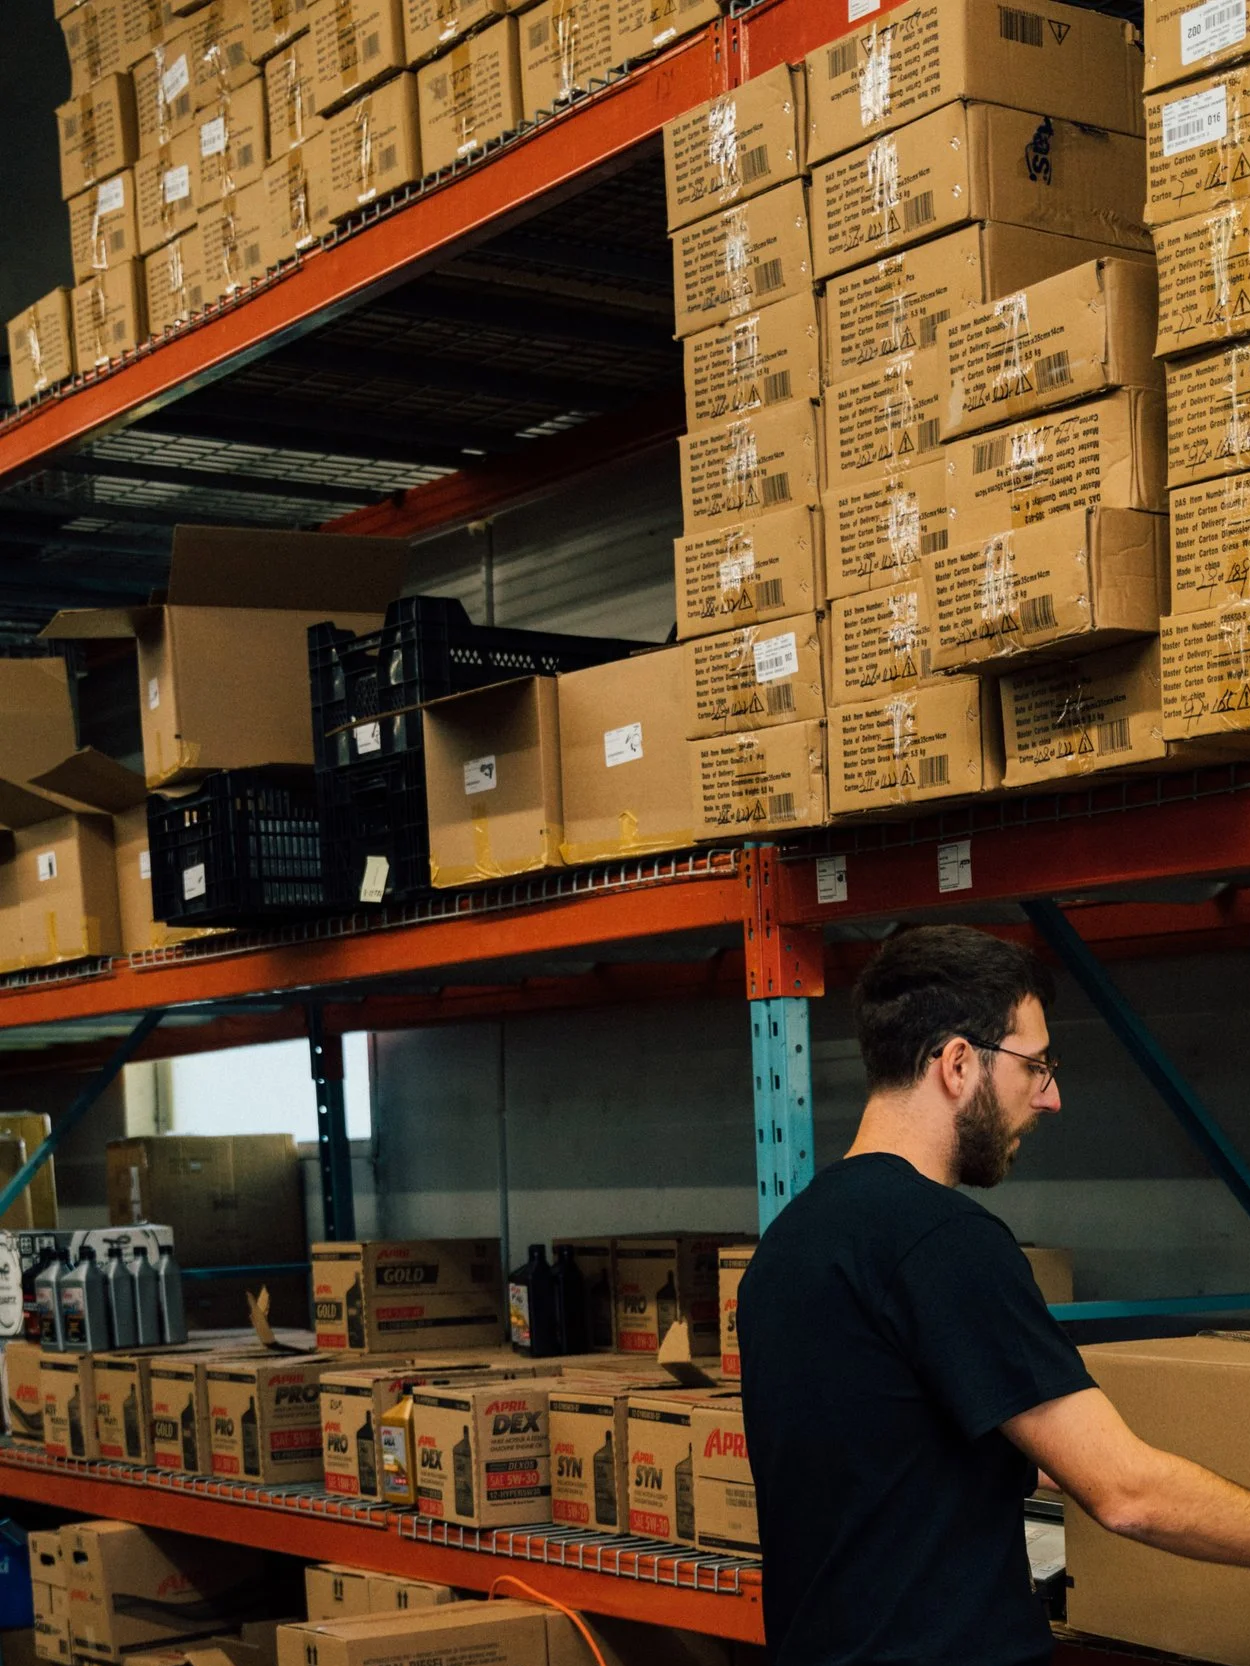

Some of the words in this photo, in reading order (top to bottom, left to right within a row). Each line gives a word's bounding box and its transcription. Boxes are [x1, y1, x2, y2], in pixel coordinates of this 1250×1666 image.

[1207, 112, 1221, 126] 016
[317, 1303, 337, 1318] GOLD
[485, 1400, 529, 1416] APRIL
[493, 1411, 542, 1435] DEX
[327, 1434, 348, 1454] PRO
[554, 1443, 575, 1455] APRIL
[704, 1428, 748, 1459] APR
[421, 1448, 442, 1470] DEX
[557, 1456, 583, 1479] SYN
[632, 1451, 655, 1465] APRIL
[635, 1466, 663, 1490] SYN
